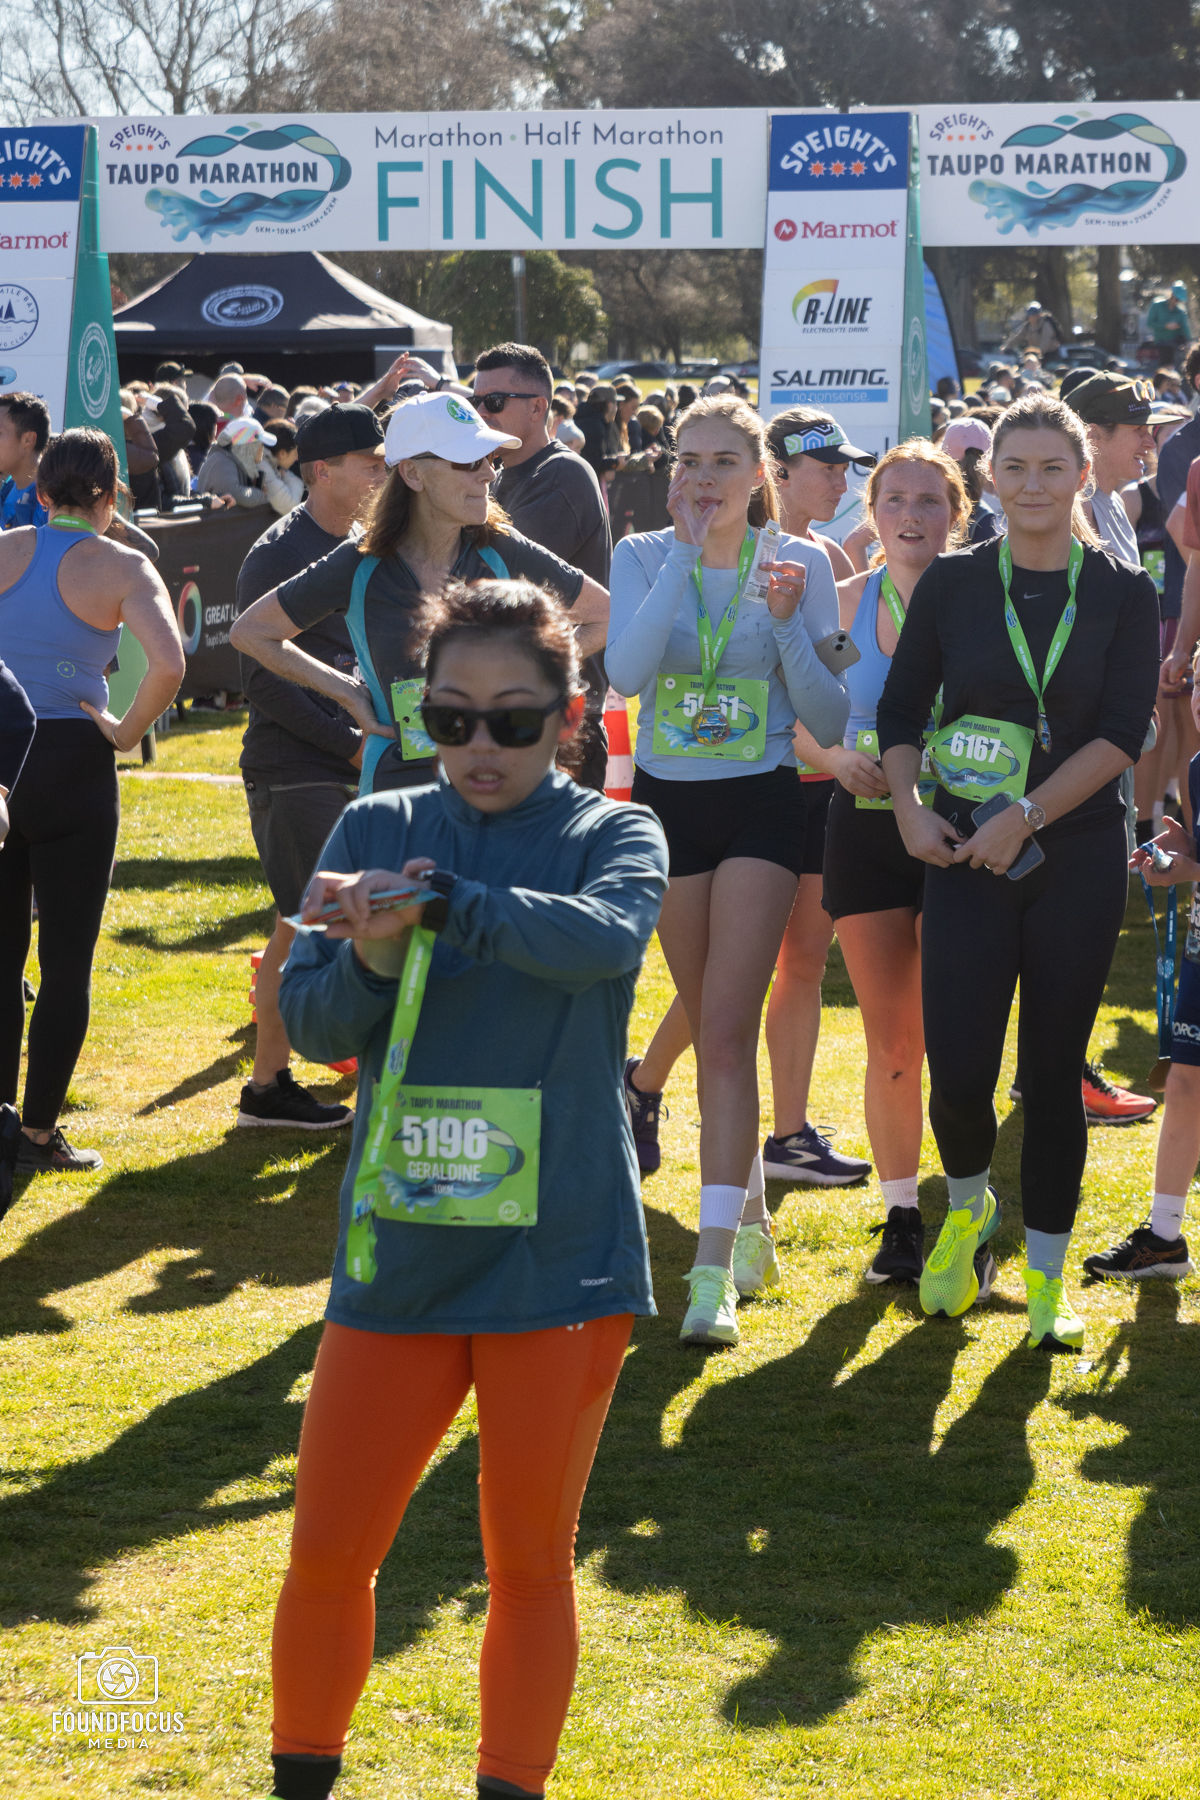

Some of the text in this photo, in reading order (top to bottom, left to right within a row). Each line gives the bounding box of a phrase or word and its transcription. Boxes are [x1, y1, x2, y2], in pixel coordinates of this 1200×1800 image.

[110, 123, 170, 150] SPEIGHT'S
[375, 120, 723, 148] Marathon Half Marathon
[930, 113, 994, 141] SPEIGHT'S
[780, 126, 897, 174] SPEIGHT'S
[106, 162, 318, 185] TAUPO MARATHON
[928, 152, 1151, 176] TAUPO MARATHON
[377, 158, 723, 241] FINISH
[0, 231, 69, 250] armot
[801, 220, 897, 239] Marmot
[803, 296, 872, 325] R-LINE
[205, 604, 230, 626] GREAT
[973, 723, 1000, 734] MARATHON
[950, 731, 1002, 763] 6167
[436, 1099, 482, 1111] MARATHON
[402, 1115, 489, 1161] 5196
[407, 1161, 483, 1182] GERALDINE
